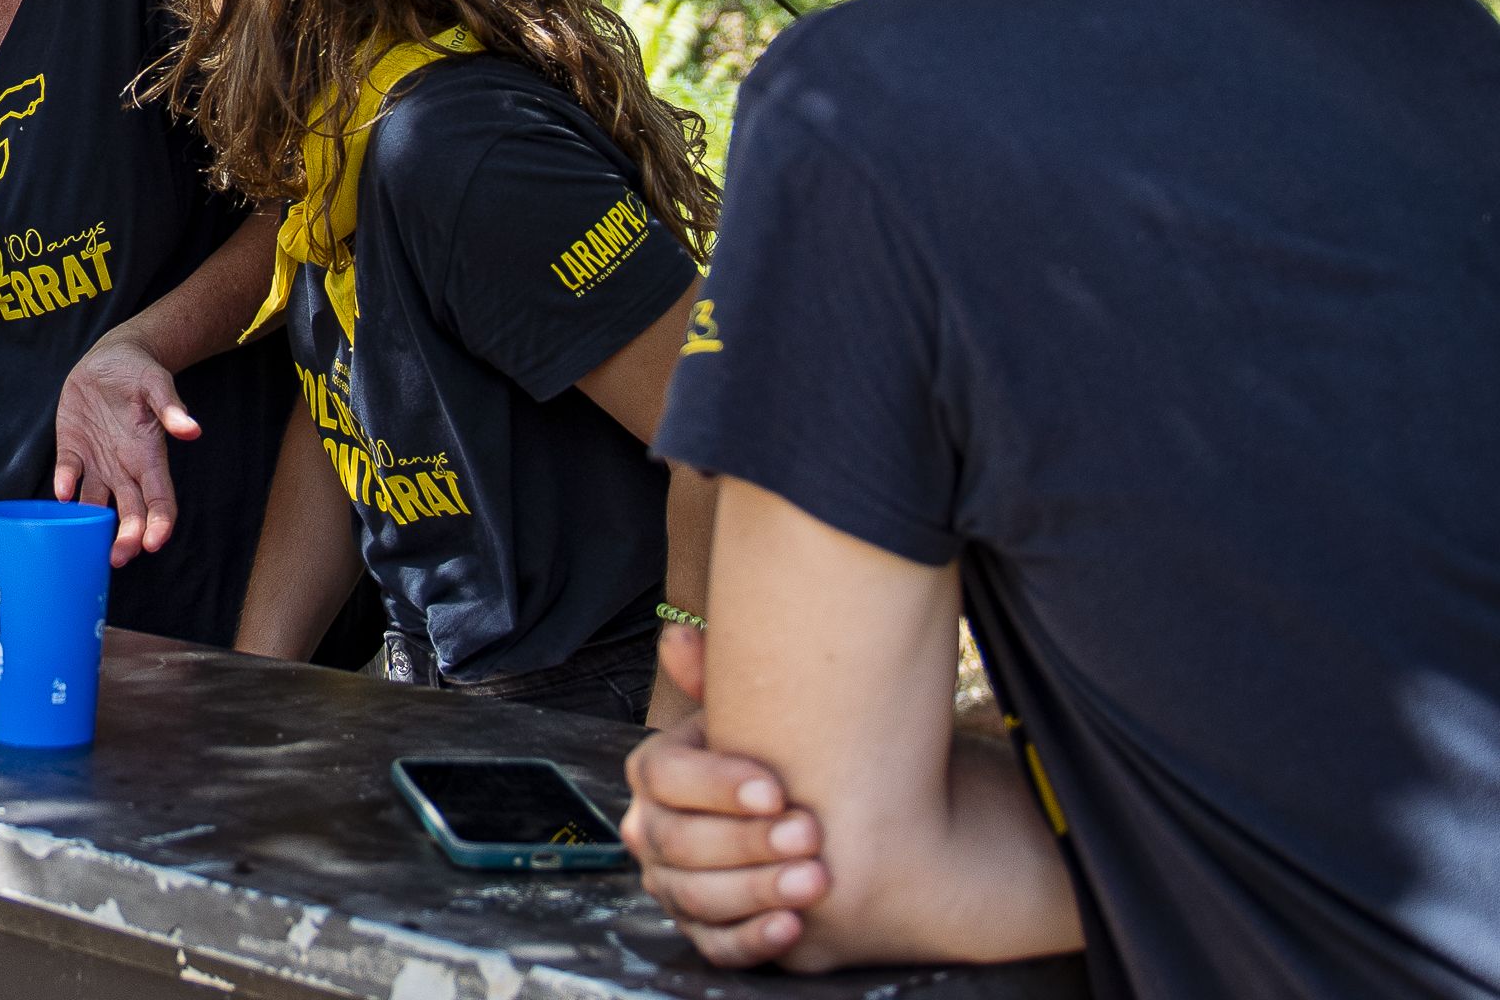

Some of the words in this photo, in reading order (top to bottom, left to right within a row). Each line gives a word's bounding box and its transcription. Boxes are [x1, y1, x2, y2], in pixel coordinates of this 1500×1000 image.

[47, 221, 106, 254] anys
[551, 201, 646, 291] LARAMPA
[576, 290, 585, 298] DE
[398, 452, 448, 476] anys
